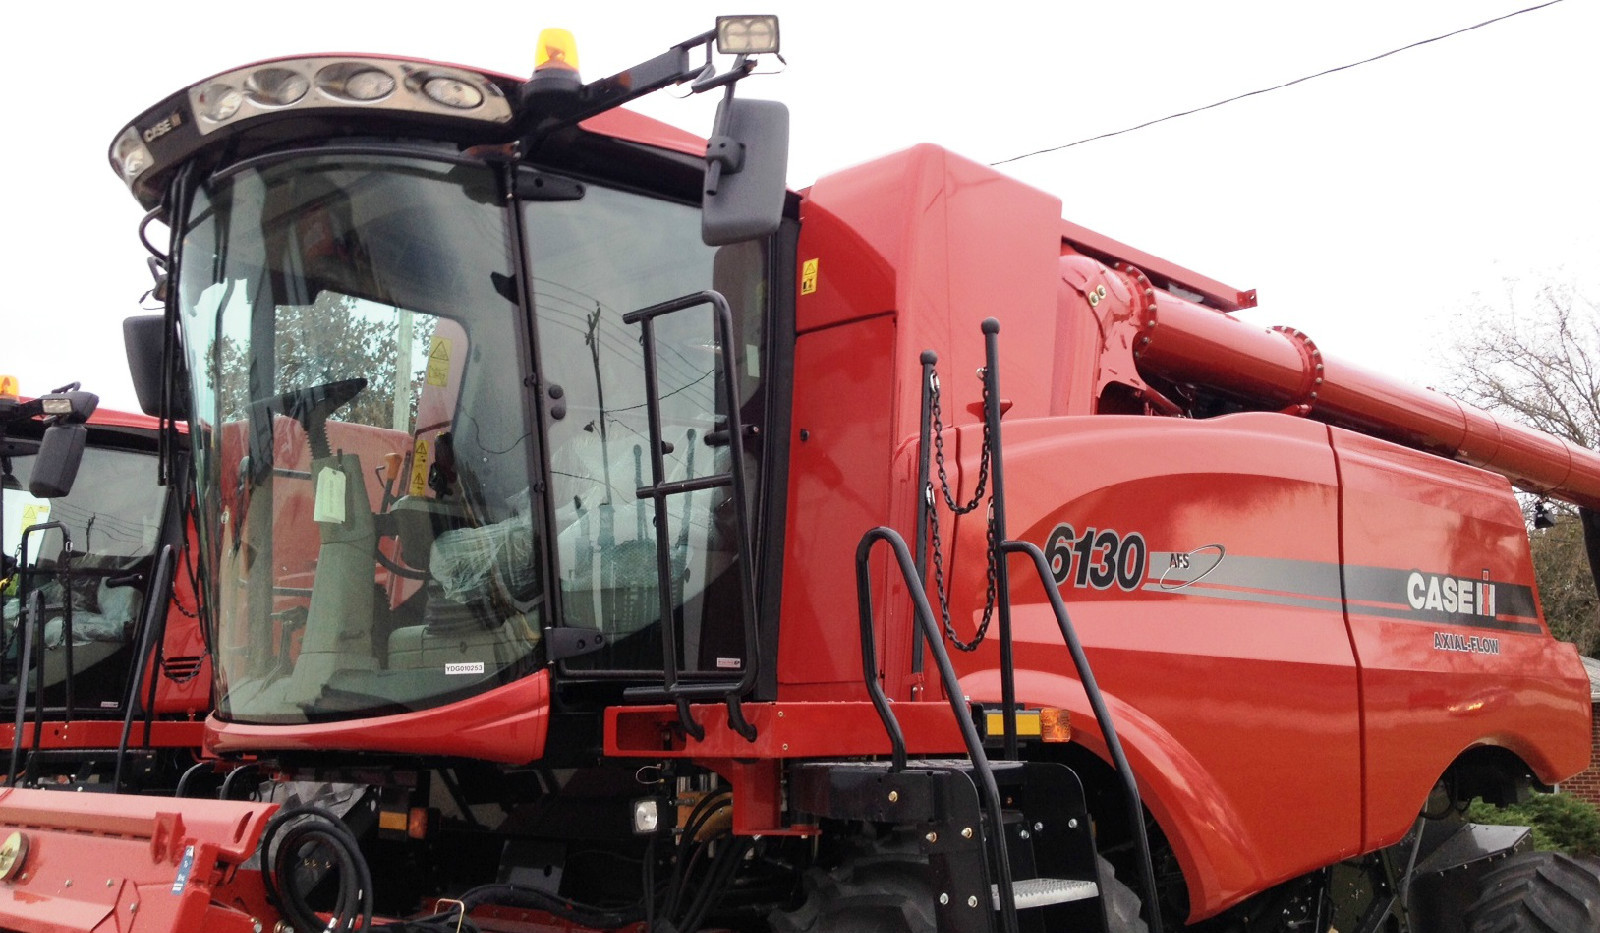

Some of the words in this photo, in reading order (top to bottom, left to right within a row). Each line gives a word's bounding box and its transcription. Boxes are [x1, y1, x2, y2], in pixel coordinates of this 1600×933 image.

[143, 119, 171, 142] CASE
[1044, 522, 1147, 592] 6130
[1169, 553, 1190, 569] AFS
[1407, 572, 1473, 614] CASE
[1433, 632, 1499, 655] AXIAL-FLOW
